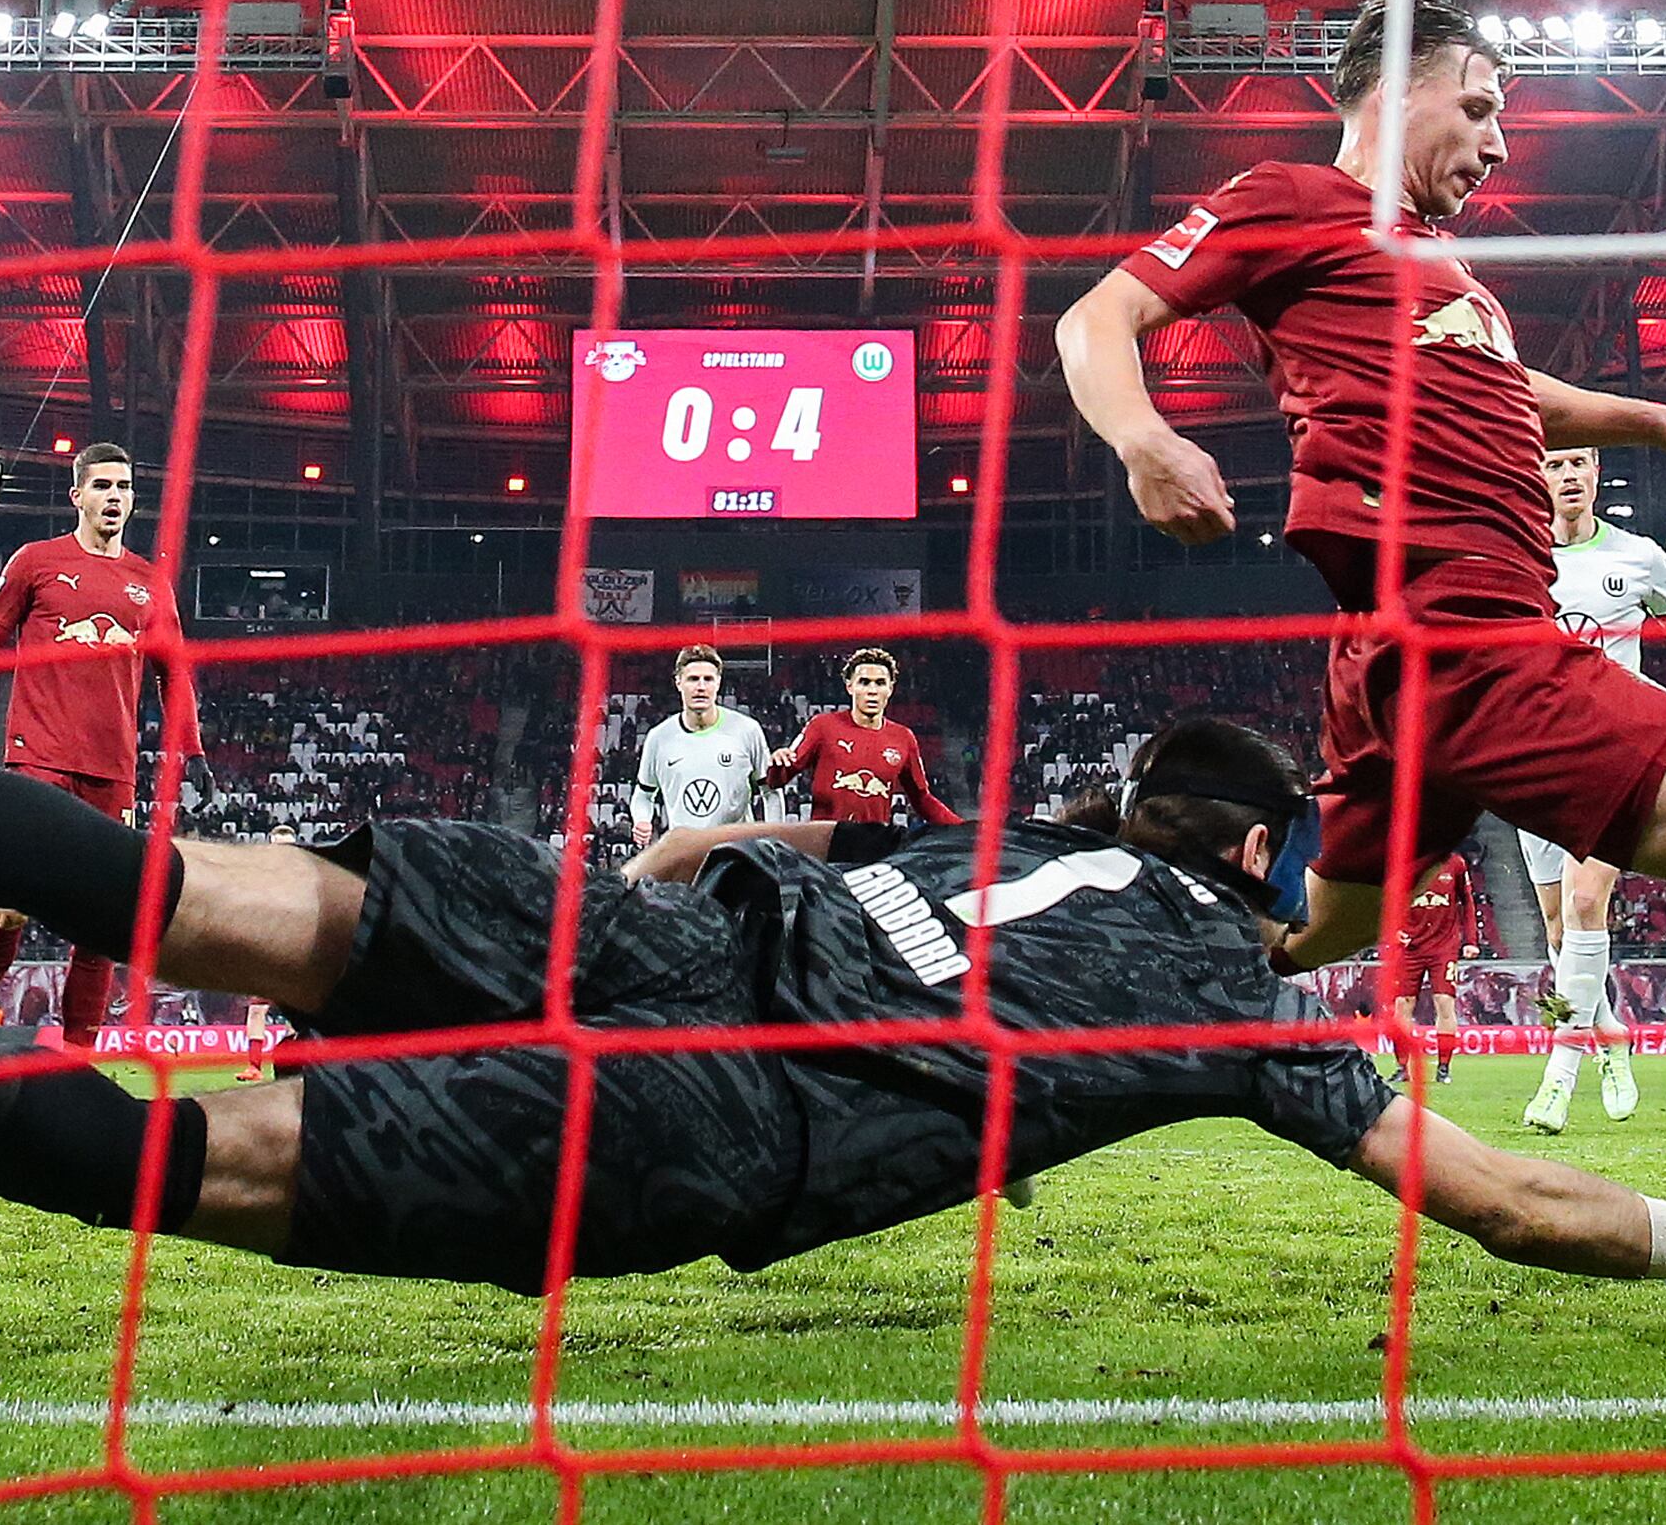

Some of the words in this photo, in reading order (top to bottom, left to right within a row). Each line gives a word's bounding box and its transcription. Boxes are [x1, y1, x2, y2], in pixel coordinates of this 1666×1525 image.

[701, 352, 785, 369] SPIELSTAND
[712, 491, 774, 512] 81:15
[842, 861, 973, 987] GRABARA
